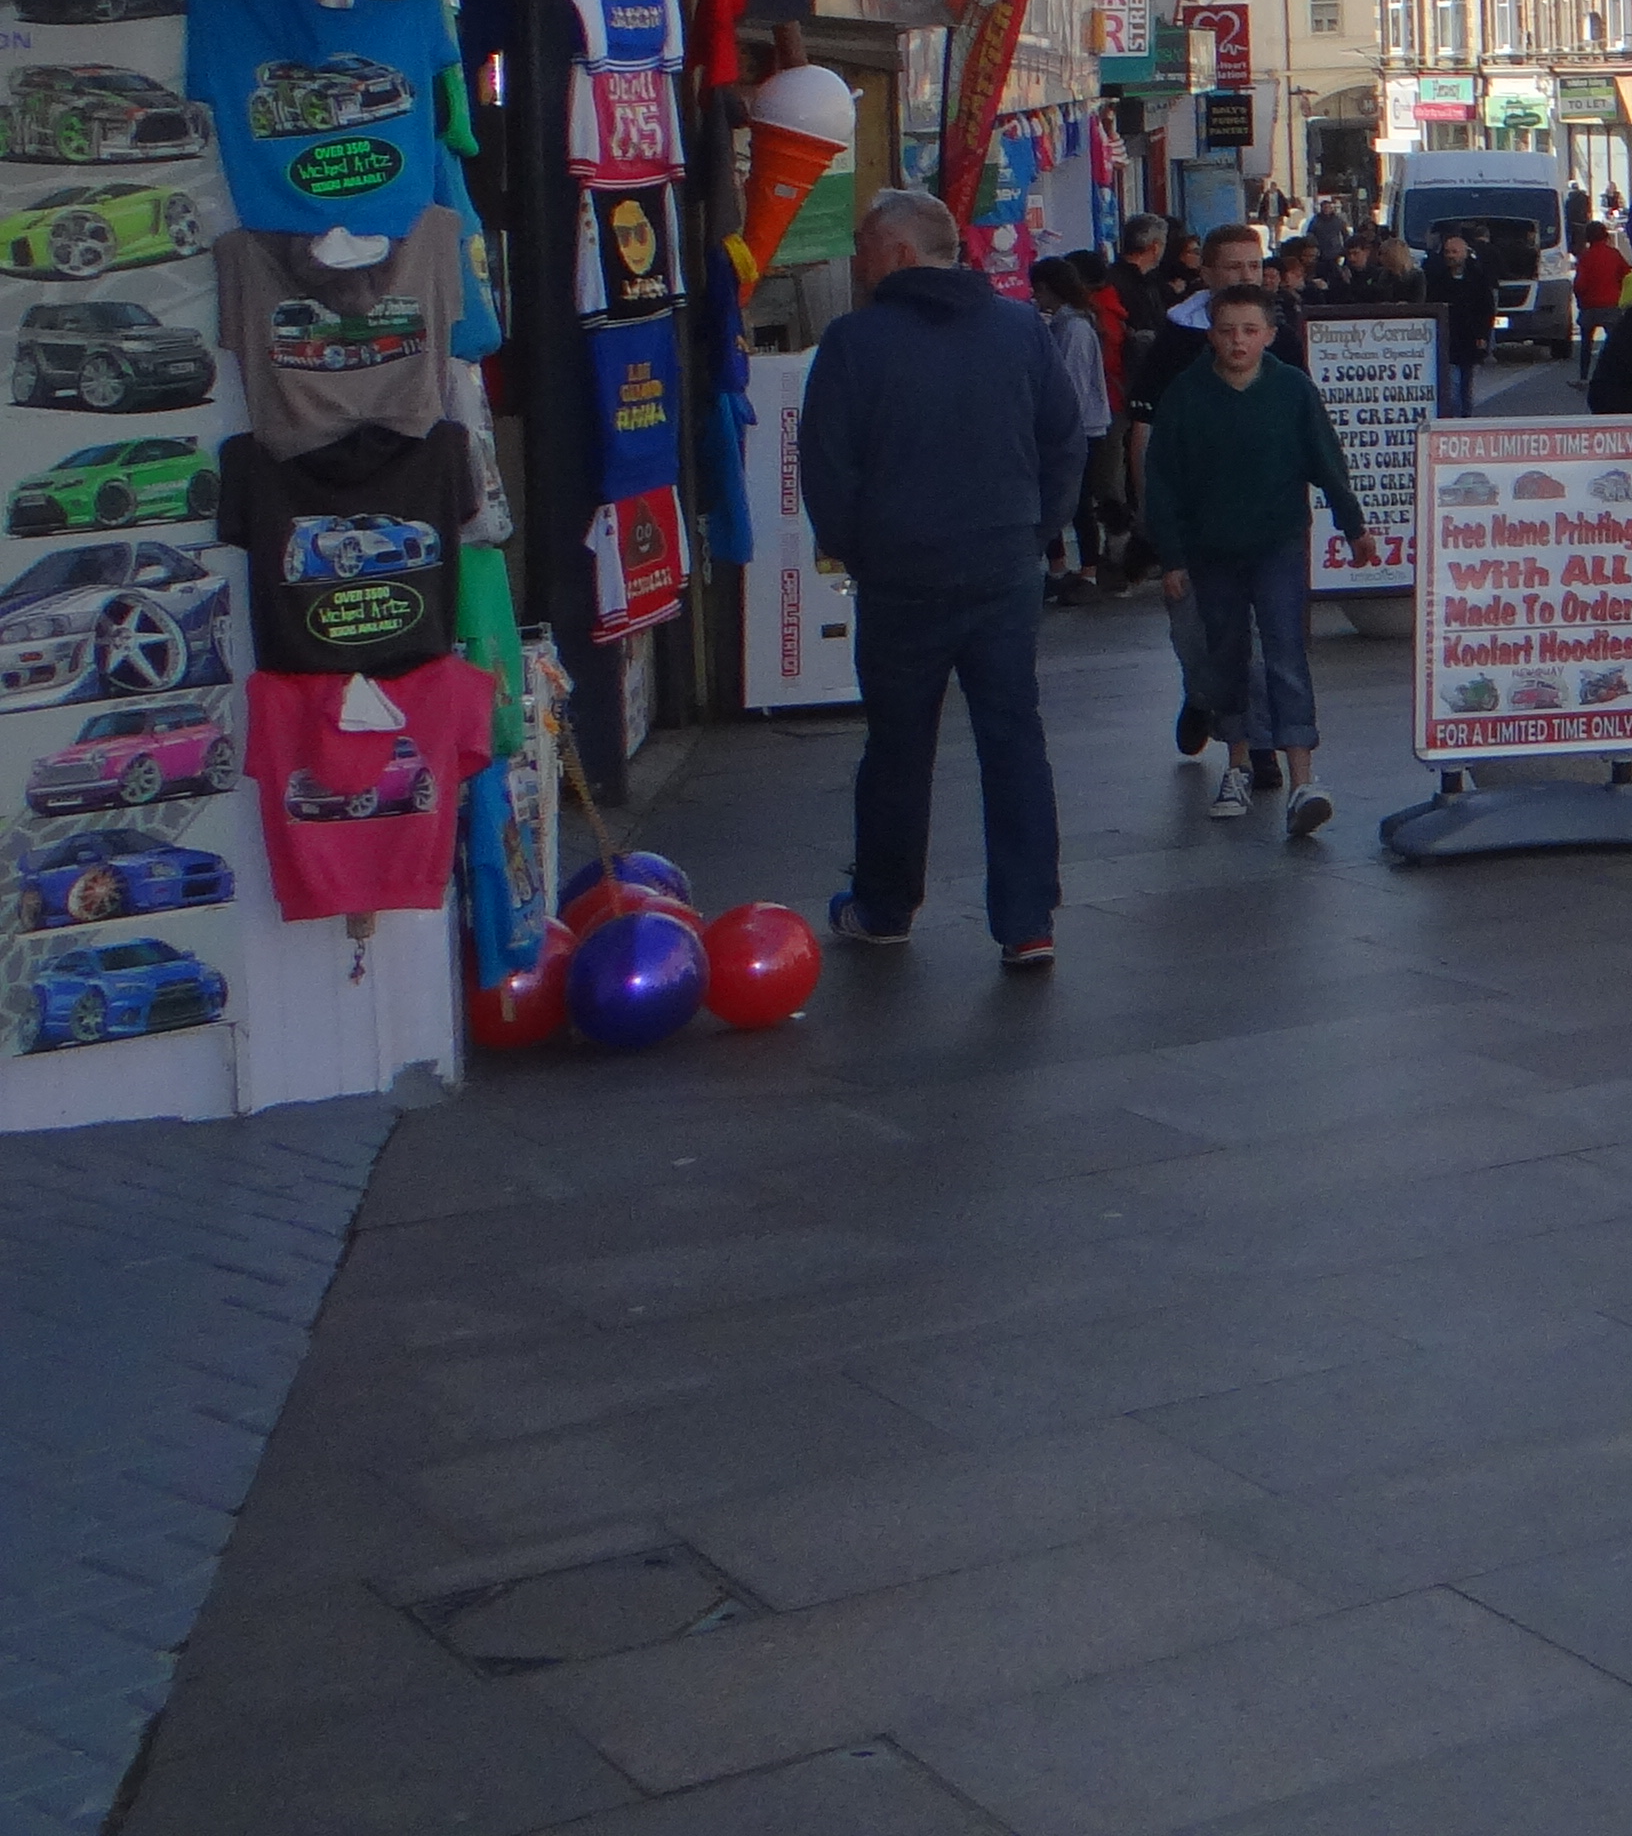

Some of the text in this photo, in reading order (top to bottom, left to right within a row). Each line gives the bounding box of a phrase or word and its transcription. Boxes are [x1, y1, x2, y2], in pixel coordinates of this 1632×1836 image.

[1568, 99, 1607, 109] TO LET
[314, 144, 345, 160] OVER
[1342, 349, 1380, 360] Cream
[1321, 363, 1423, 383] 2 SCOOPS OF
[1320, 384, 1436, 404] ANDMADE CORNISH
[1328, 406, 1427, 426] CE CREAM
[1340, 429, 1416, 448] PPED WIT
[1439, 436, 1470, 459] FOR
[1475, 436, 1485, 457] A
[1490, 433, 1550, 457] LIMITED
[1555, 431, 1590, 455] TIME
[1375, 450, 1414, 469] CORN
[1380, 472, 1415, 491] CREA
[1441, 515, 1486, 550] Free
[1491, 514, 1550, 549] Name
[1448, 556, 1550, 591] With
[1560, 554, 1632, 587] ALL
[333, 589, 363, 605] OVER
[1444, 594, 1517, 627] Made
[1522, 593, 1555, 625] To
[1443, 633, 1534, 668] Koolart
[1436, 723, 1468, 746] FOR
[1472, 722, 1484, 745] A
[1487, 719, 1547, 744] LIMITED
[1552, 716, 1587, 740] TIME
